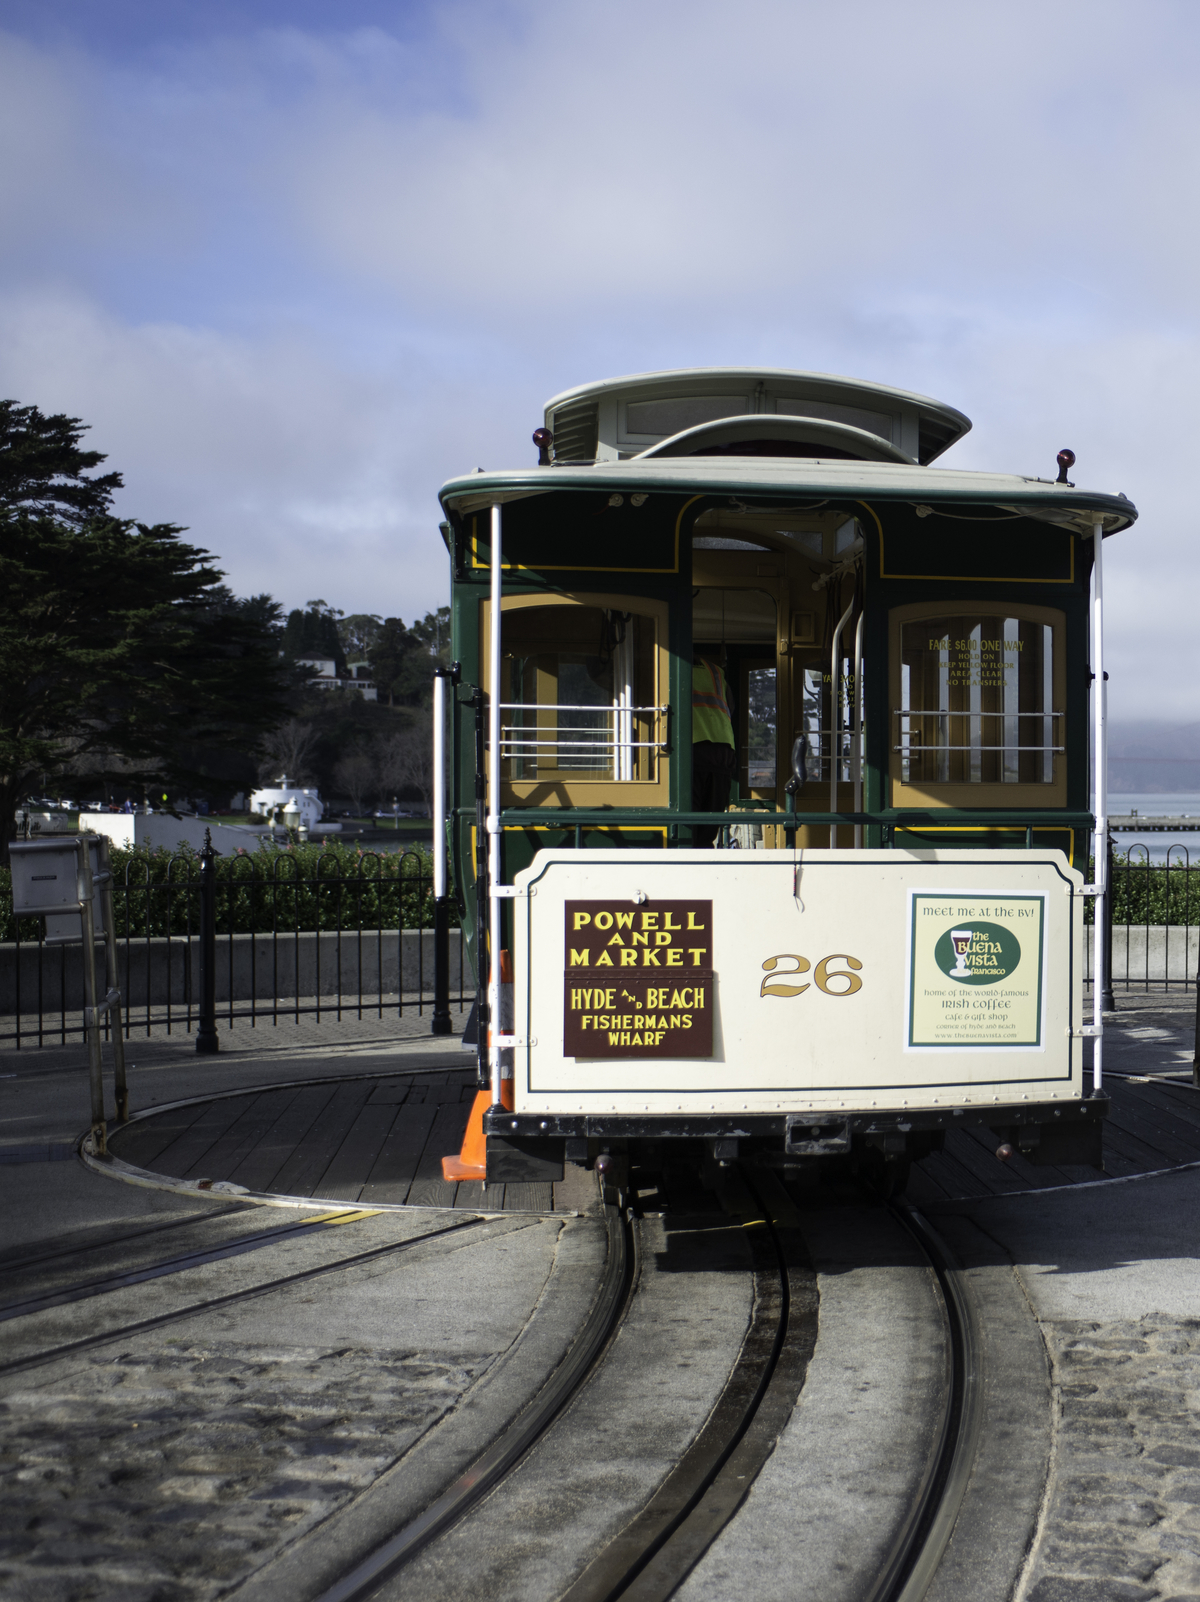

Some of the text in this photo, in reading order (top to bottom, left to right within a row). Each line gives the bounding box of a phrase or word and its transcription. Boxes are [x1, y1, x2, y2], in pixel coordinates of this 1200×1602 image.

[928, 639, 1025, 652] FARE $6.00 ONE WAY
[938, 661, 957, 669] KEEP
[958, 661, 988, 669] YELLOW
[962, 679, 1008, 687] TRANSFERS
[923, 906, 954, 917] meet
[957, 907, 976, 917] me
[978, 907, 992, 917] at
[994, 906, 1015, 918] the
[573, 911, 705, 930] POWELL
[607, 931, 673, 946] AND
[972, 931, 989, 941] the
[570, 948, 707, 967] MARKET
[760, 953, 863, 998] 26
[571, 987, 705, 1010] HYDE AND BEACH
[924, 989, 947, 997] home
[948, 989, 958, 998] of
[959, 989, 973, 997] the
[582, 1014, 693, 1030] FISHERMANS
[945, 1013, 963, 1022] cafe
[964, 1013, 970, 1021] &
[988, 1013, 1009, 1022] shop
[960, 1023, 968, 1031] of
[608, 1031, 666, 1046] WHARF
